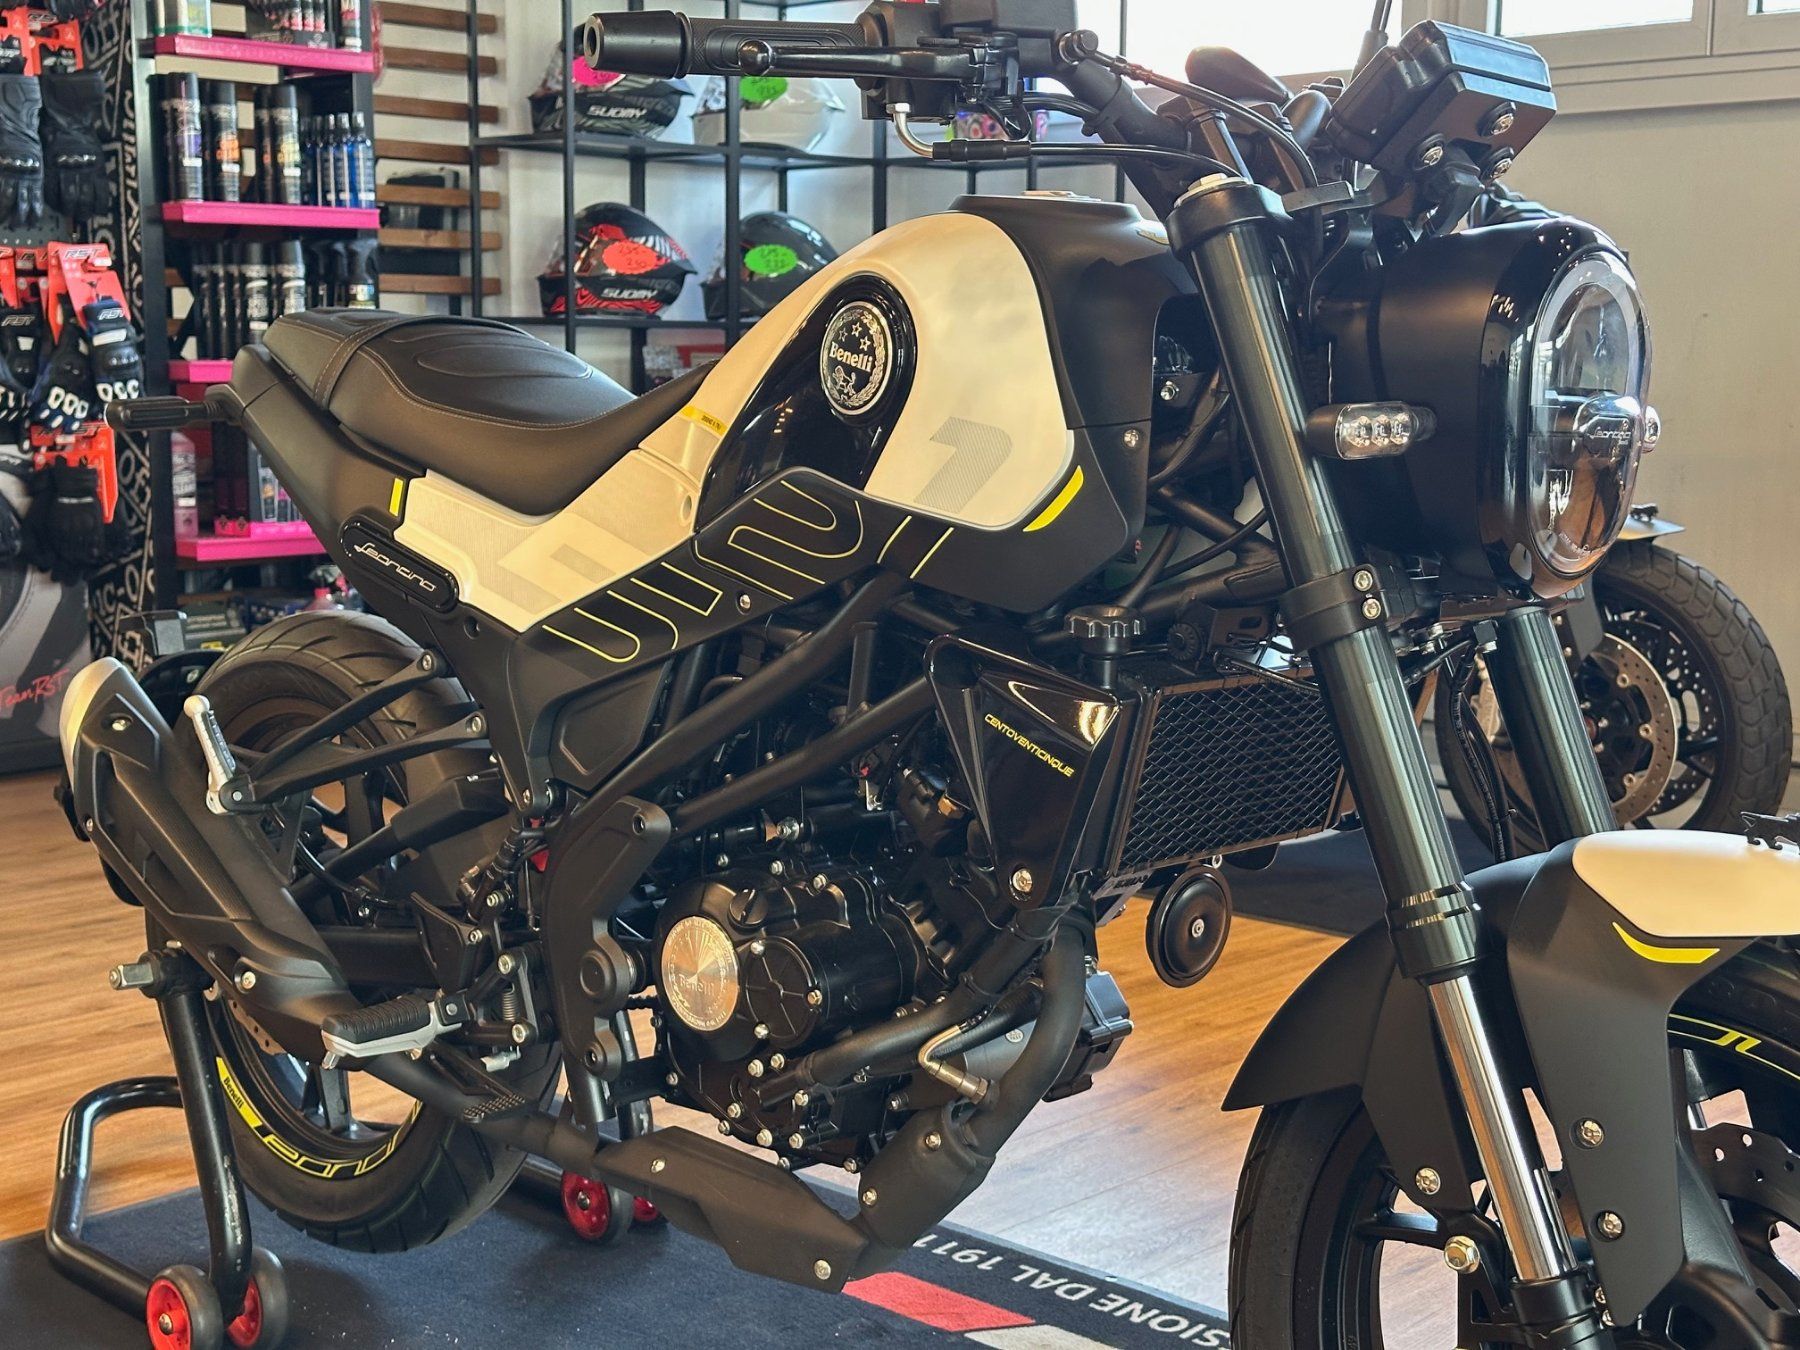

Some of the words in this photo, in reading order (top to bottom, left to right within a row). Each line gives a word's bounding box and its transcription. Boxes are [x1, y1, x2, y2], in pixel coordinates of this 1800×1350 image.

[588, 105, 647, 119] SUOMY
[65, 248, 103, 259] RST
[602, 287, 658, 300] SUOMY
[829, 341, 873, 373] Benelli
[984, 713, 1075, 778] CENTOVENTICINQUE
[222, 1076, 245, 1109] Benelli
[912, 1233, 1004, 1270] 1911
[1011, 1264, 1098, 1301] DAL
[1088, 1293, 1232, 1350] SIONE
